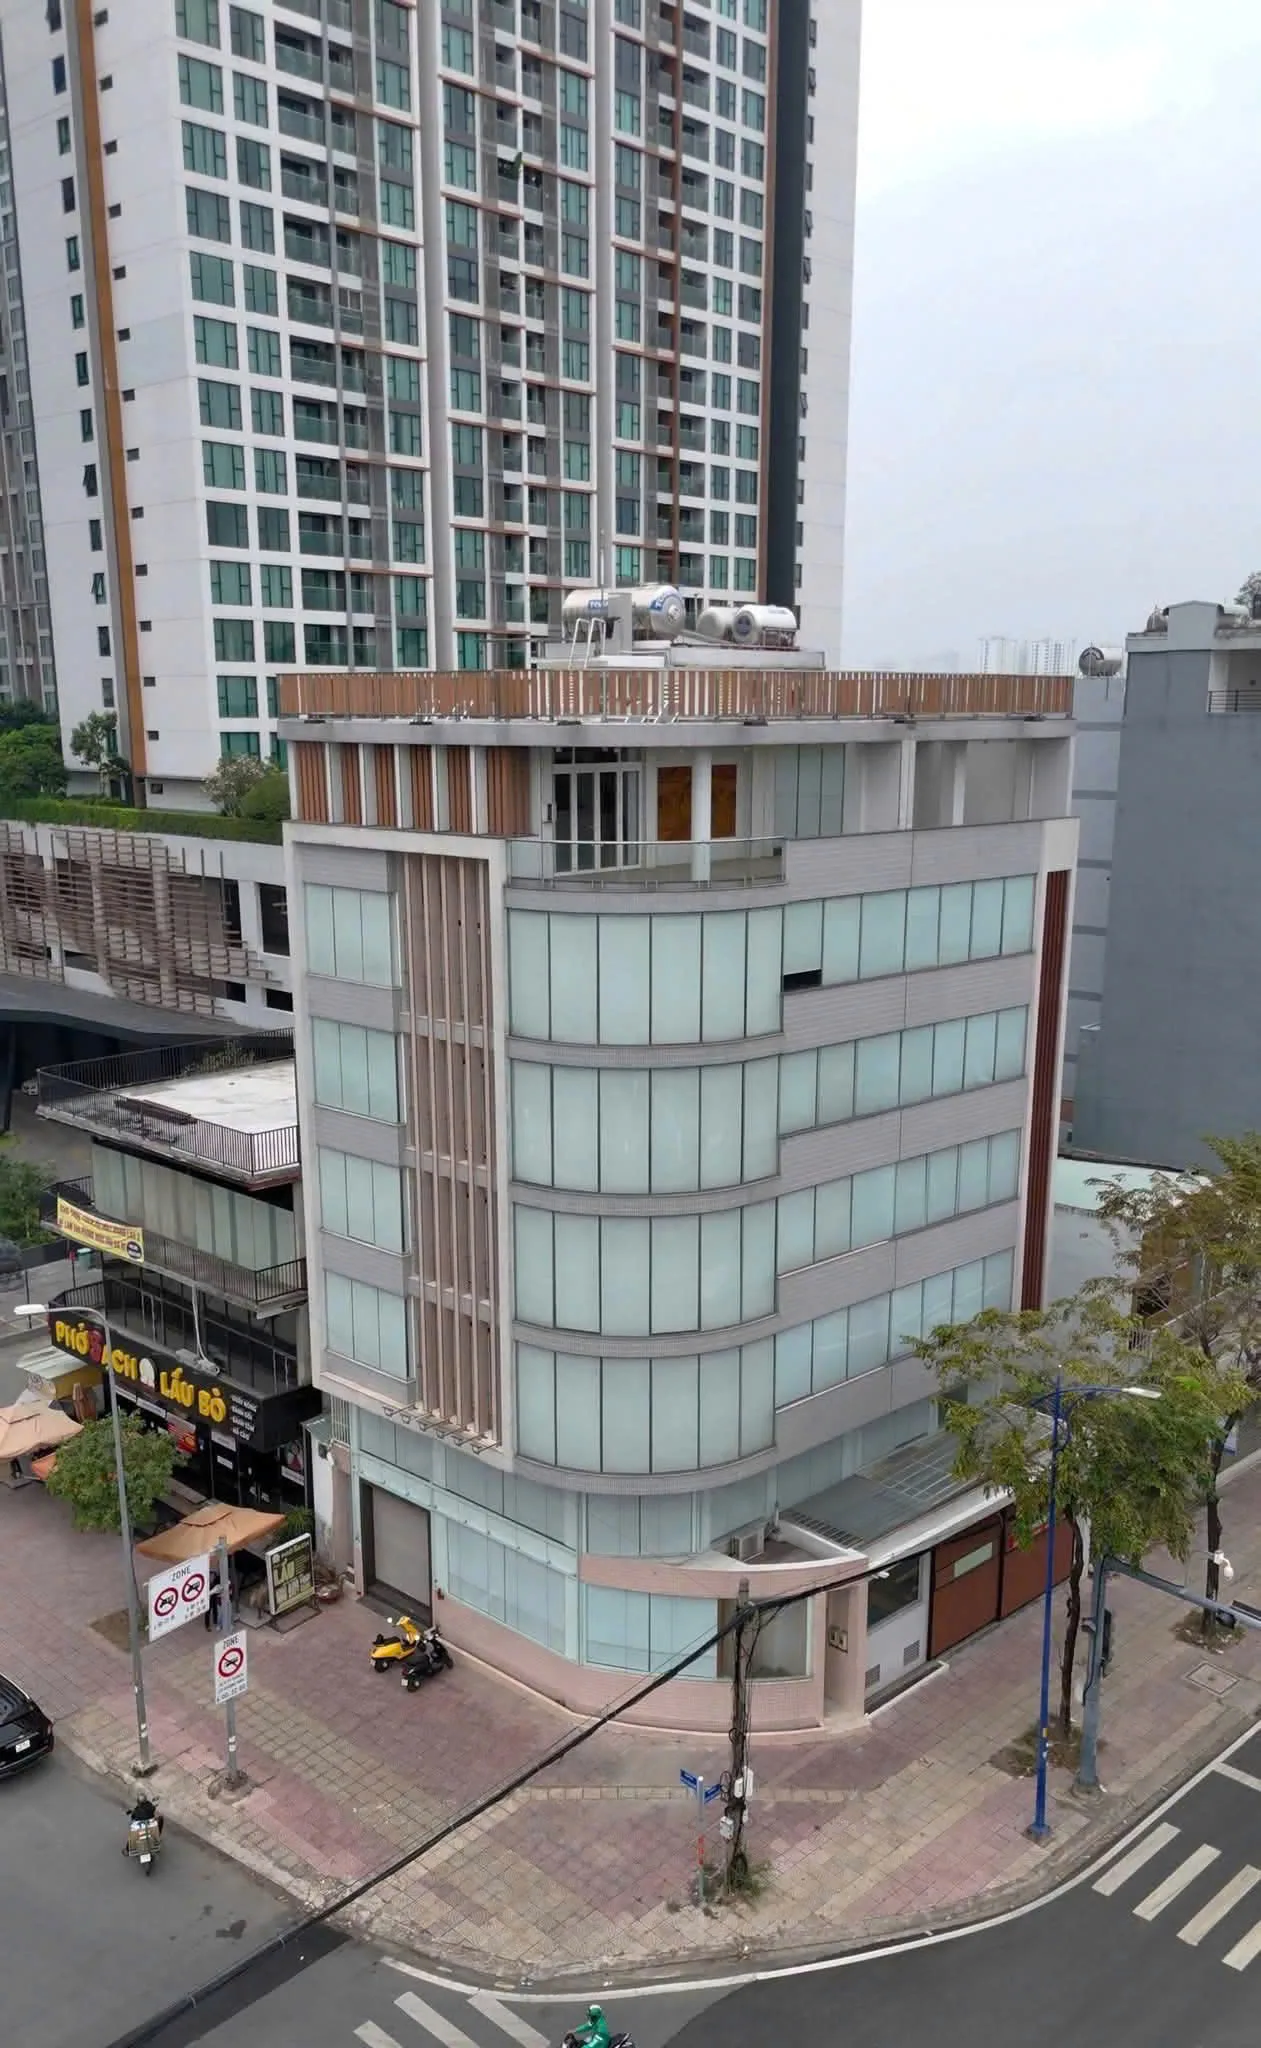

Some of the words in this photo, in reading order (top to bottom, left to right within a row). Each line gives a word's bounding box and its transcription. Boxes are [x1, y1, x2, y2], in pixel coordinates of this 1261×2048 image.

[55, 1320, 89, 1355] PHỞ
[198, 1387, 226, 1423] BÒ
[171, 1565, 192, 1582] ZONE
[223, 1635, 240, 1650] ZONE
